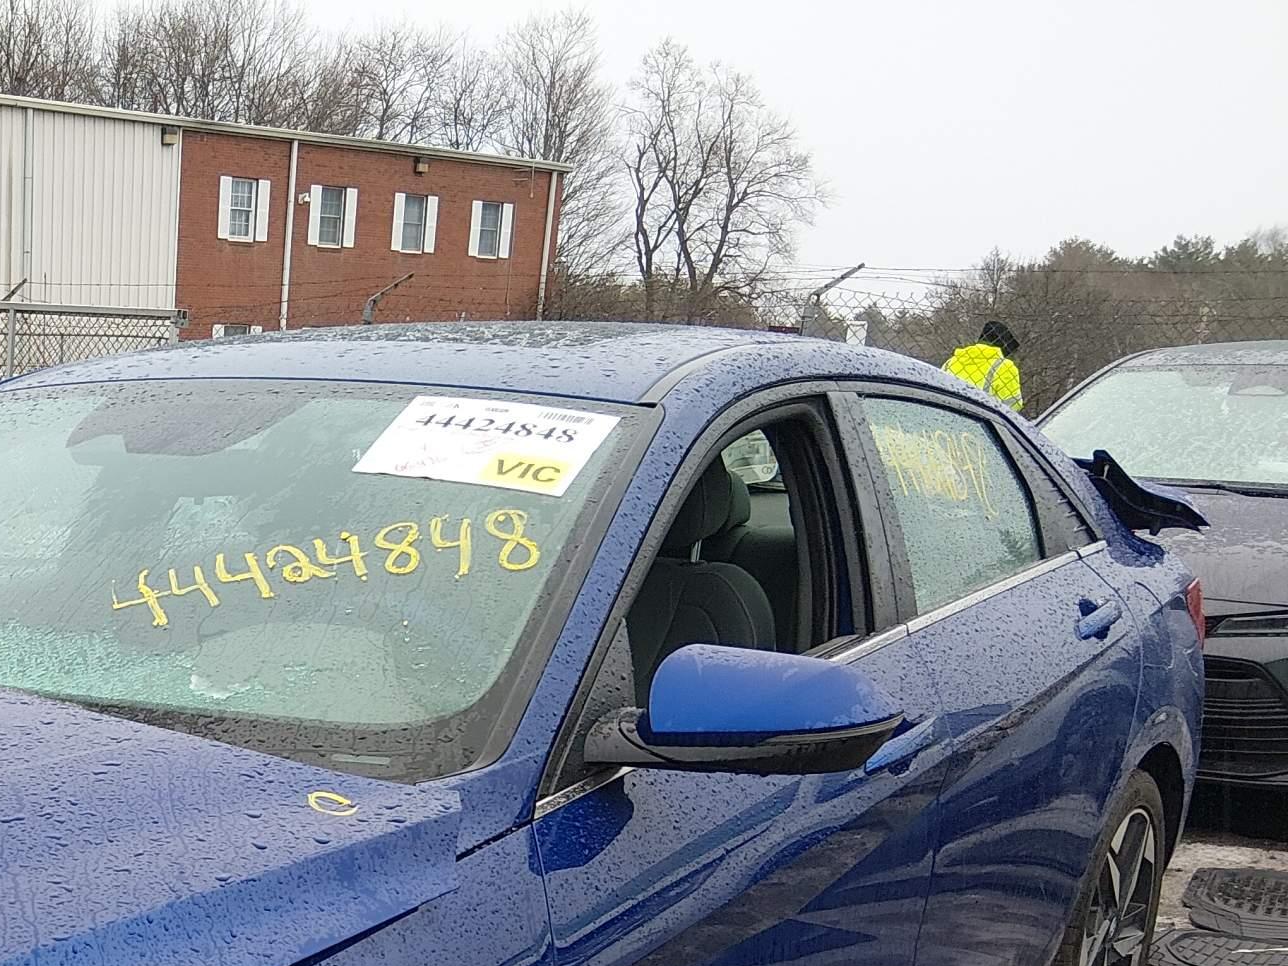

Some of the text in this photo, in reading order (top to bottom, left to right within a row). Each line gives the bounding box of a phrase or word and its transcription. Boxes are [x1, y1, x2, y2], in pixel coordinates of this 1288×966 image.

[415, 413, 578, 443] 44424848
[496, 458, 561, 484] VIC
[112, 509, 540, 627] 44424848
